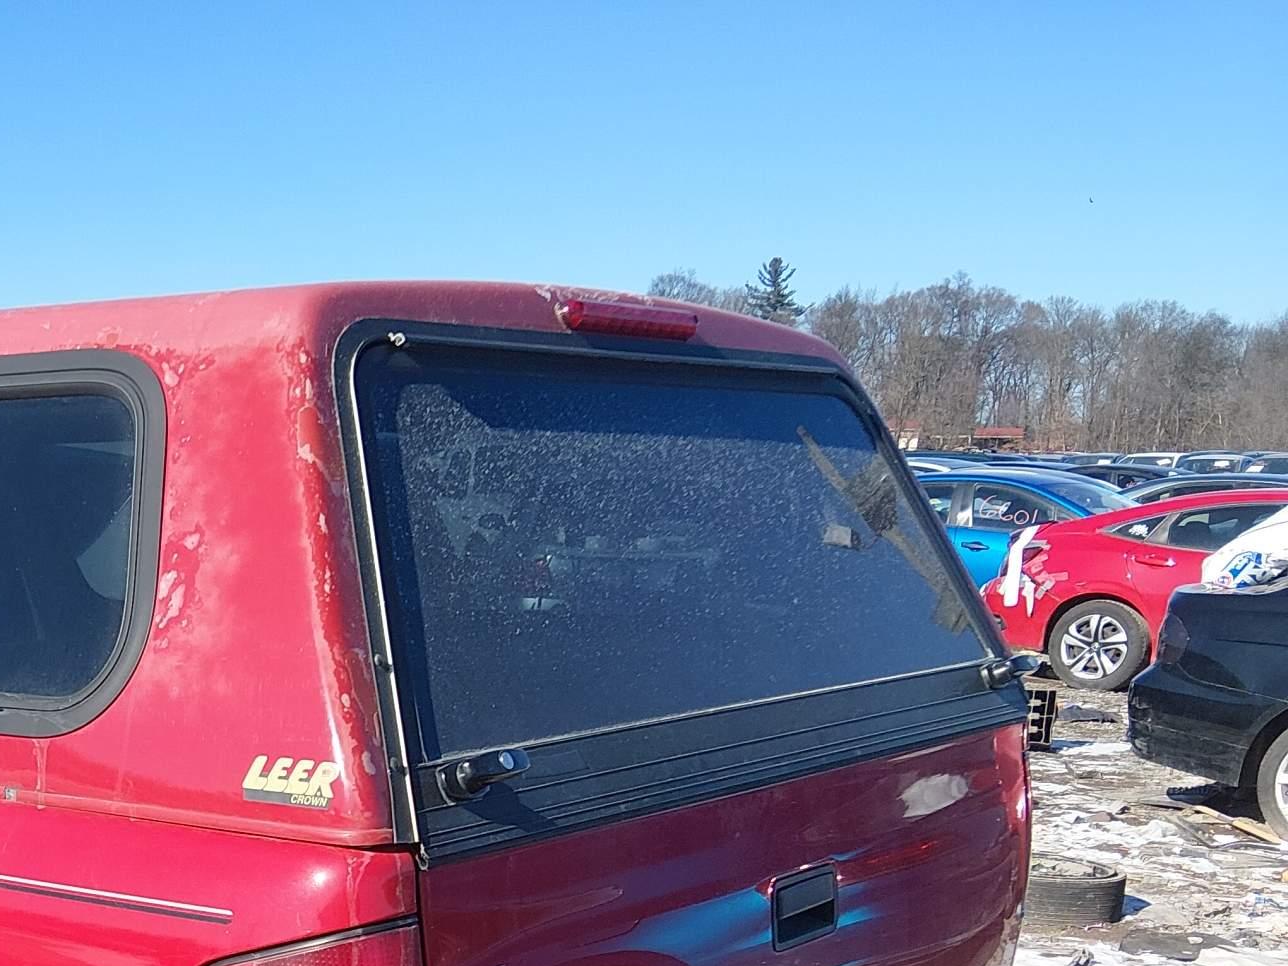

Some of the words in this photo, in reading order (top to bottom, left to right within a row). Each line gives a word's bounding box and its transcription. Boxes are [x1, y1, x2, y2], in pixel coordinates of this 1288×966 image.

[979, 494, 1039, 525] 6601
[241, 754, 339, 798] LEER
[290, 794, 328, 808] CROWN
